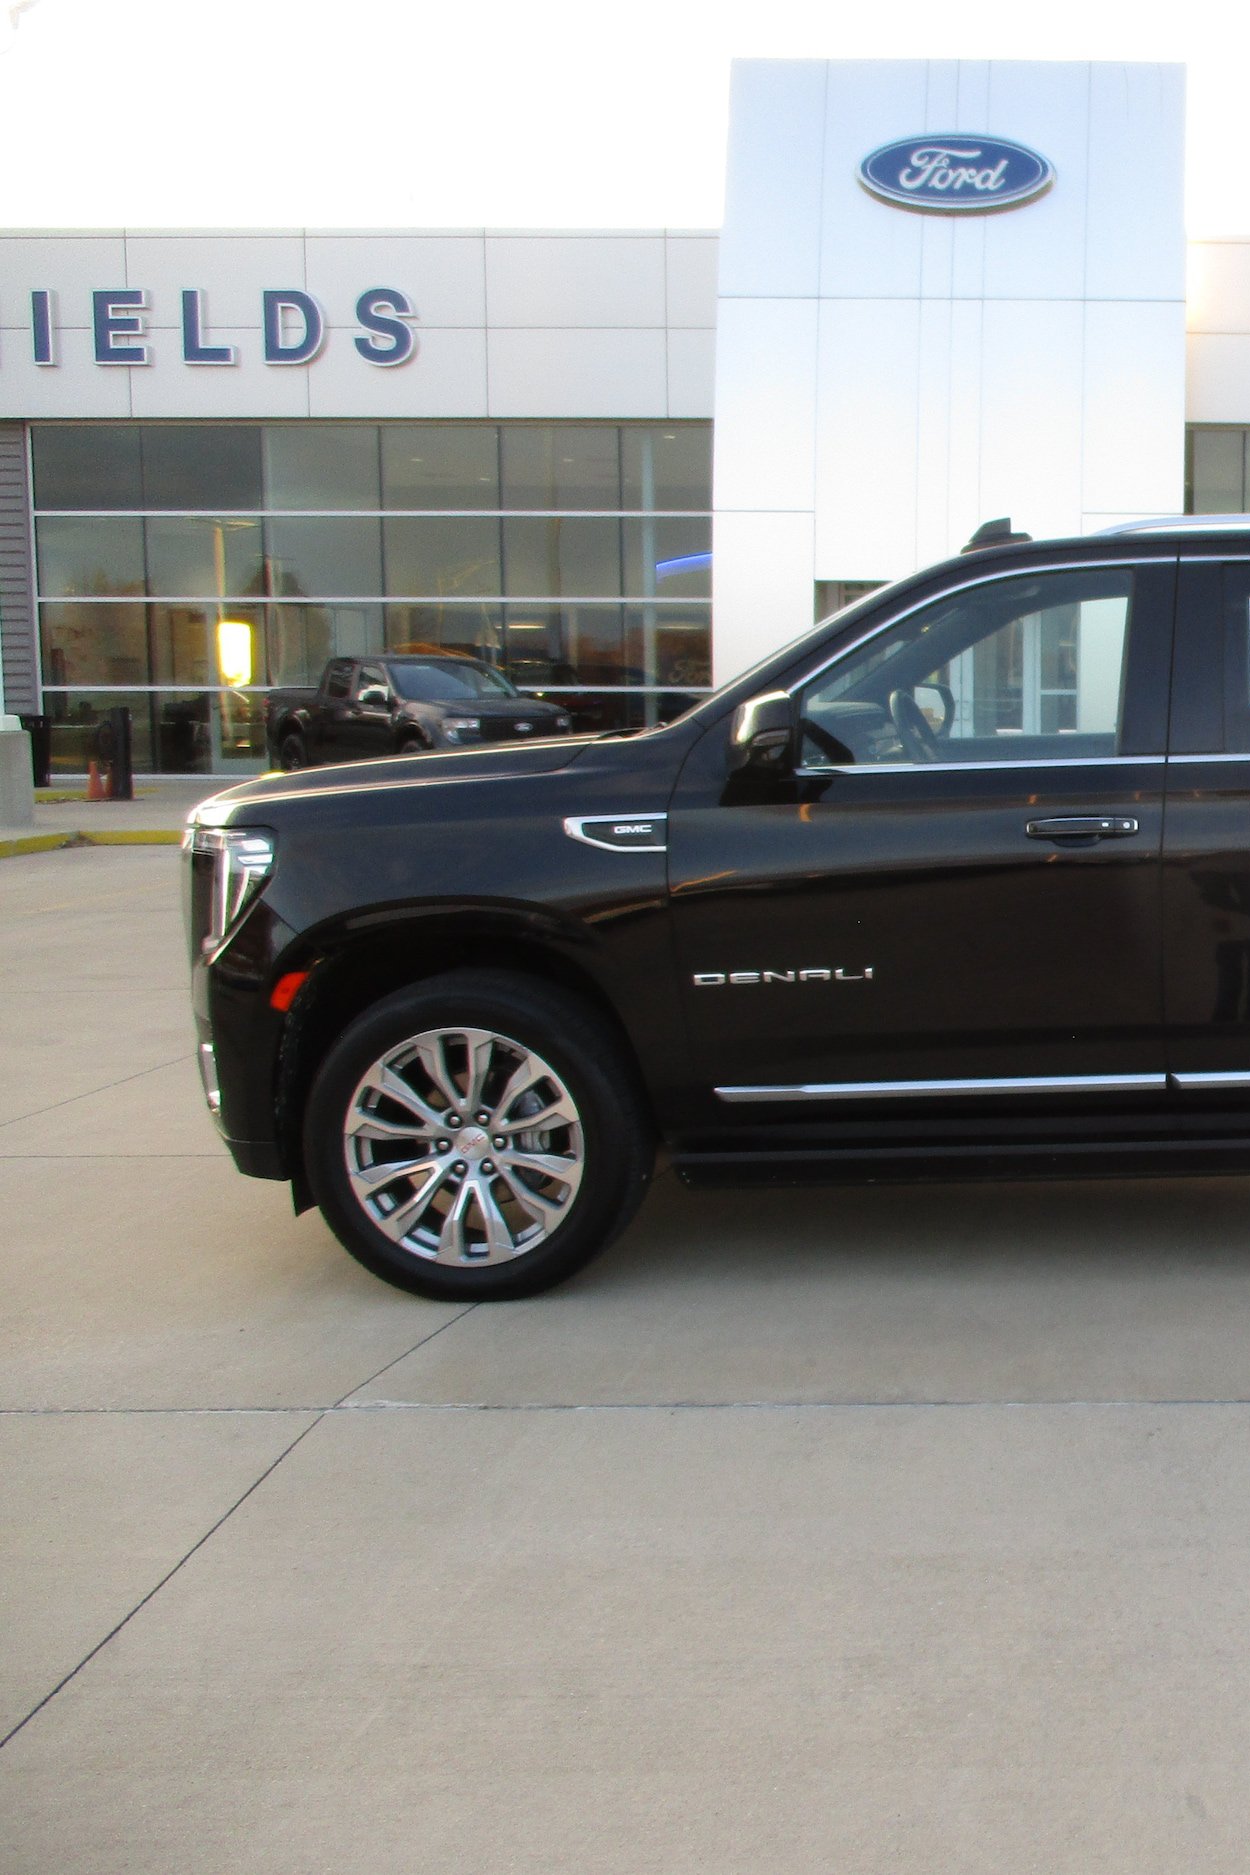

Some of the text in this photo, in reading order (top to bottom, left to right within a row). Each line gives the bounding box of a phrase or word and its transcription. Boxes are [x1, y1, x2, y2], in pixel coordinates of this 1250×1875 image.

[899, 148, 1009, 190] Ford
[613, 824, 652, 834] GMC
[693, 967, 874, 986] DENALI
